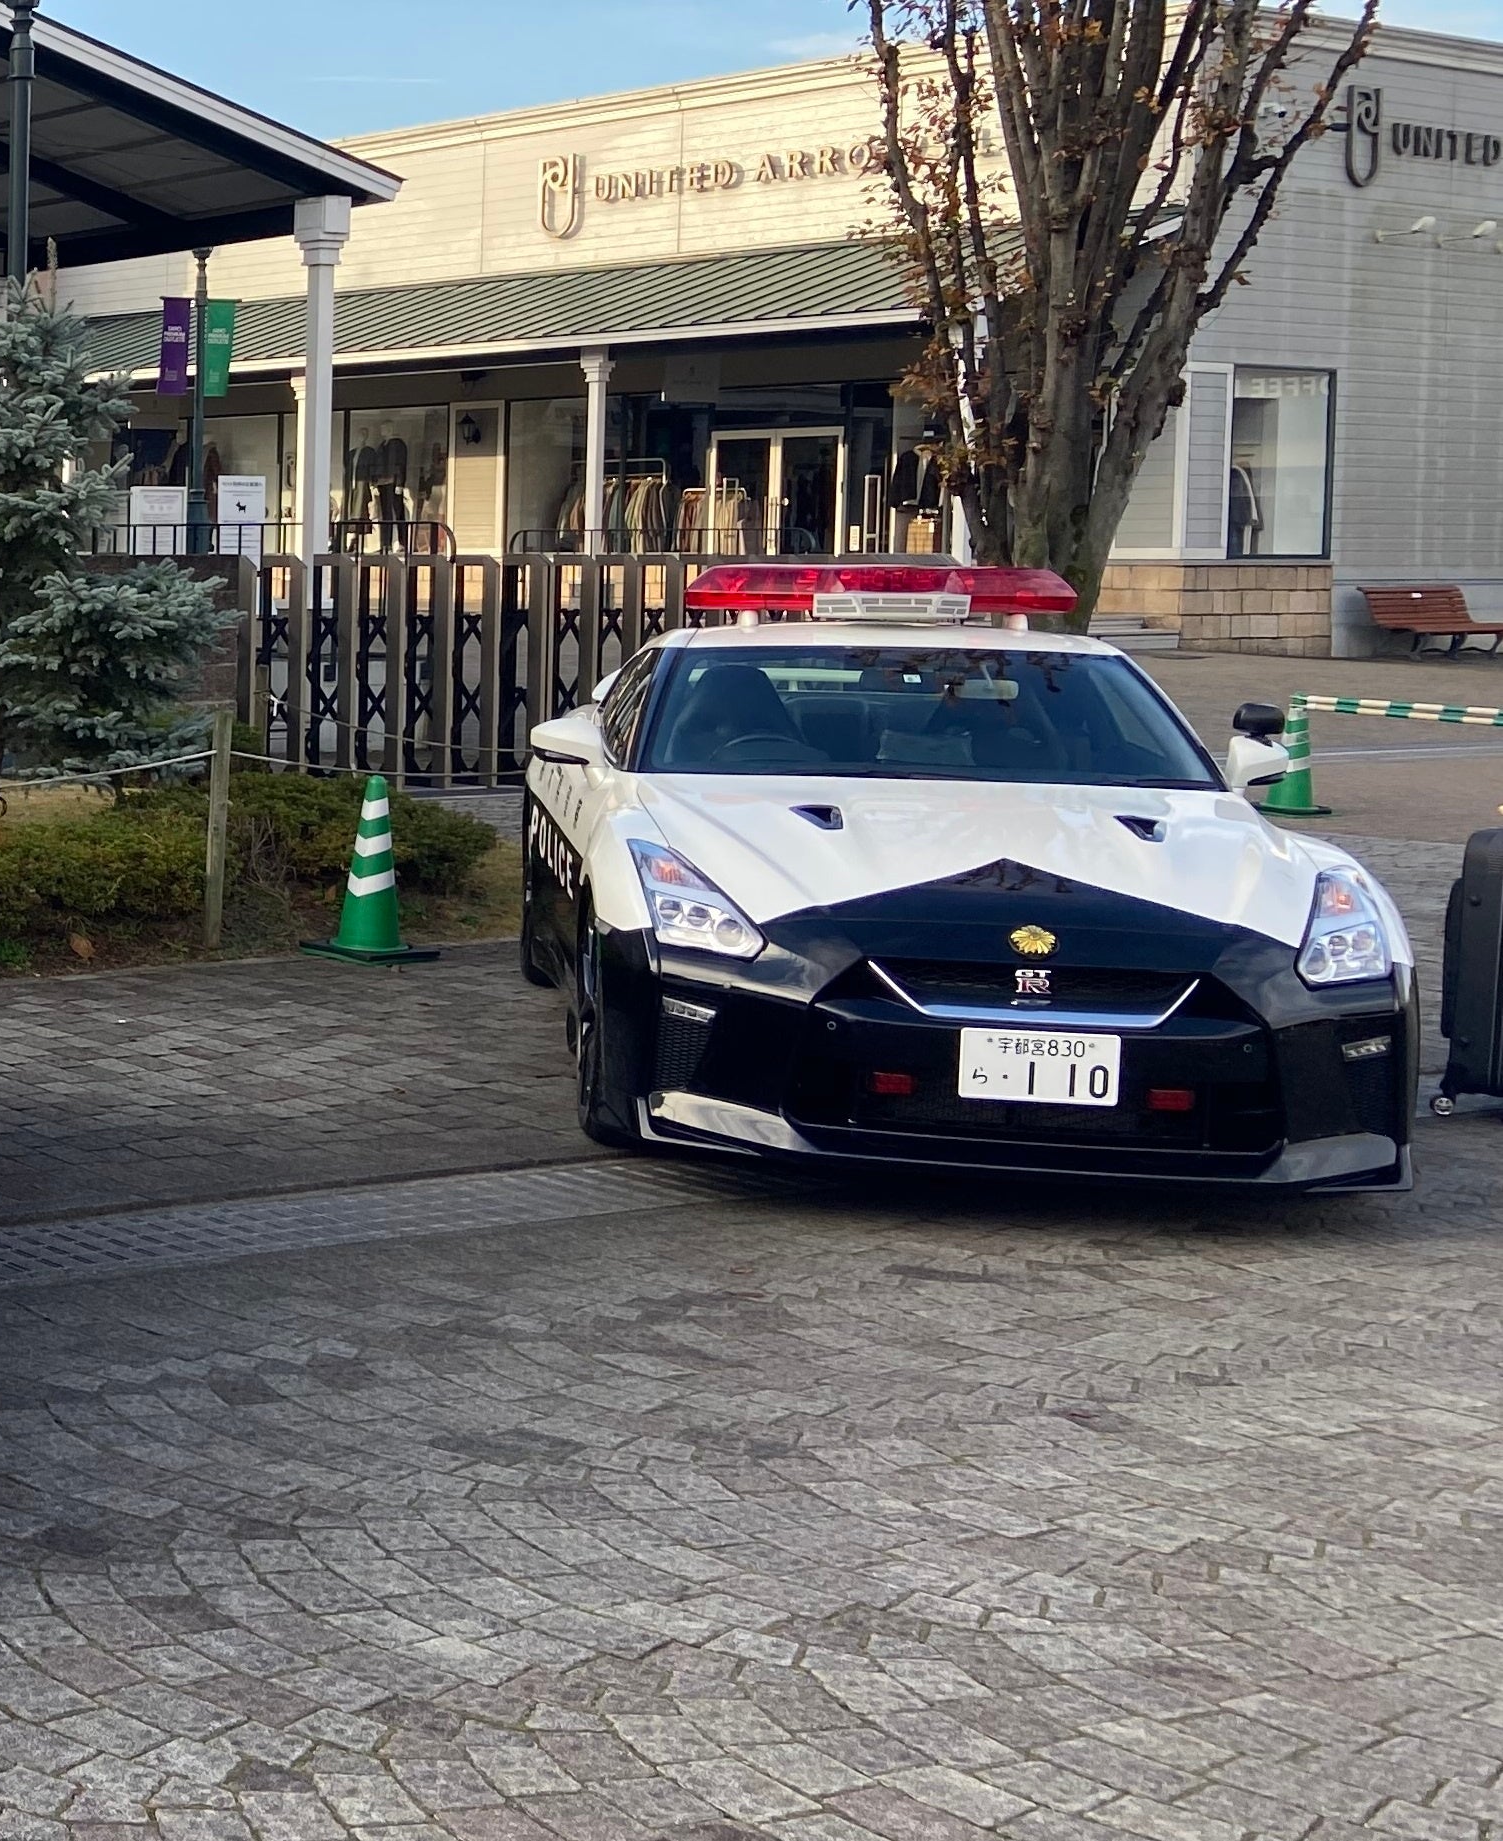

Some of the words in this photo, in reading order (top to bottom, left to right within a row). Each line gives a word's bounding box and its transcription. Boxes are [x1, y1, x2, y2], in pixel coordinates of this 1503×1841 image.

[1392, 123, 1501, 166] UNITED
[594, 159, 734, 201] UNITED
[528, 804, 574, 901] POLICE
[1014, 969, 1052, 978] GT
